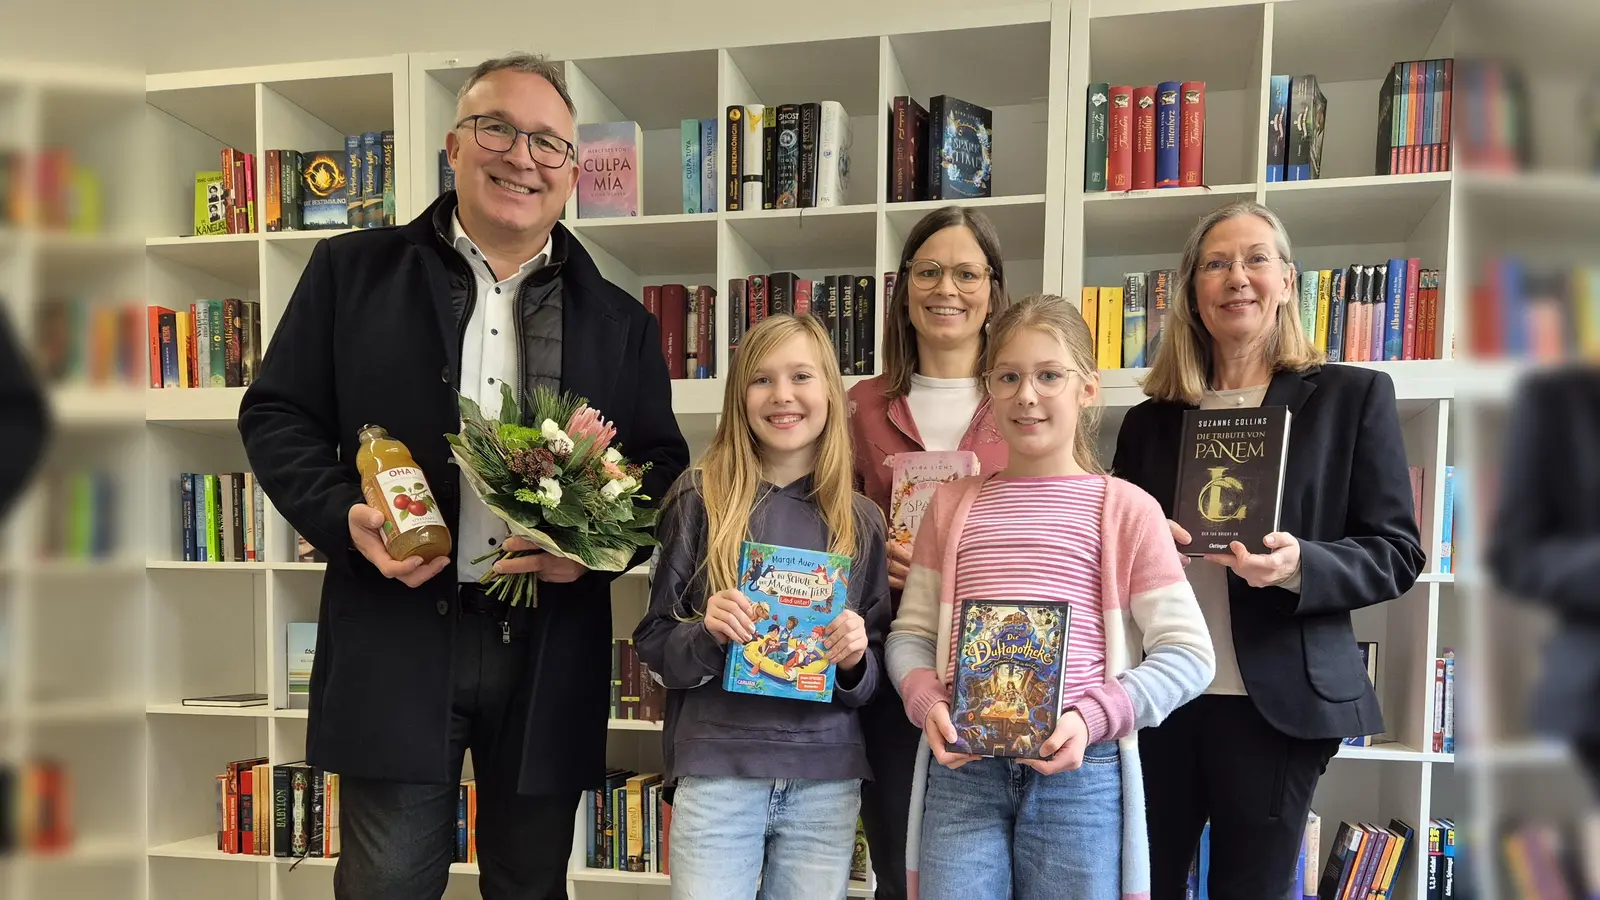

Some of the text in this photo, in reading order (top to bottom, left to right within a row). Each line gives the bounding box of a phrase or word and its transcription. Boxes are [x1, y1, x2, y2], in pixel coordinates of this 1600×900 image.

[778, 113, 799, 121] GHOST
[1143, 115, 1152, 152] Tintenblut
[1166, 110, 1176, 148] Tintenherz
[584, 158, 631, 172] CULPA
[594, 172, 623, 191] MÍA
[196, 221, 226, 235] KÄNGUR
[1154, 272, 1167, 309] Harry Potter
[827, 286, 836, 318] Krabat
[843, 285, 851, 317] Krabat
[1198, 417, 1268, 428] SUZANNE COLLINS
[1194, 439, 1264, 463] PANEM
[906, 500, 929, 512] SPA
[772, 556, 815, 568] Margit Auer
[768, 579, 808, 596] MAGISCHEN
[808, 586, 829, 599] TIERE
[786, 572, 810, 586] SCHULE
[968, 638, 1053, 671] Duftapotheke
[276, 788, 286, 827] BABYLON
